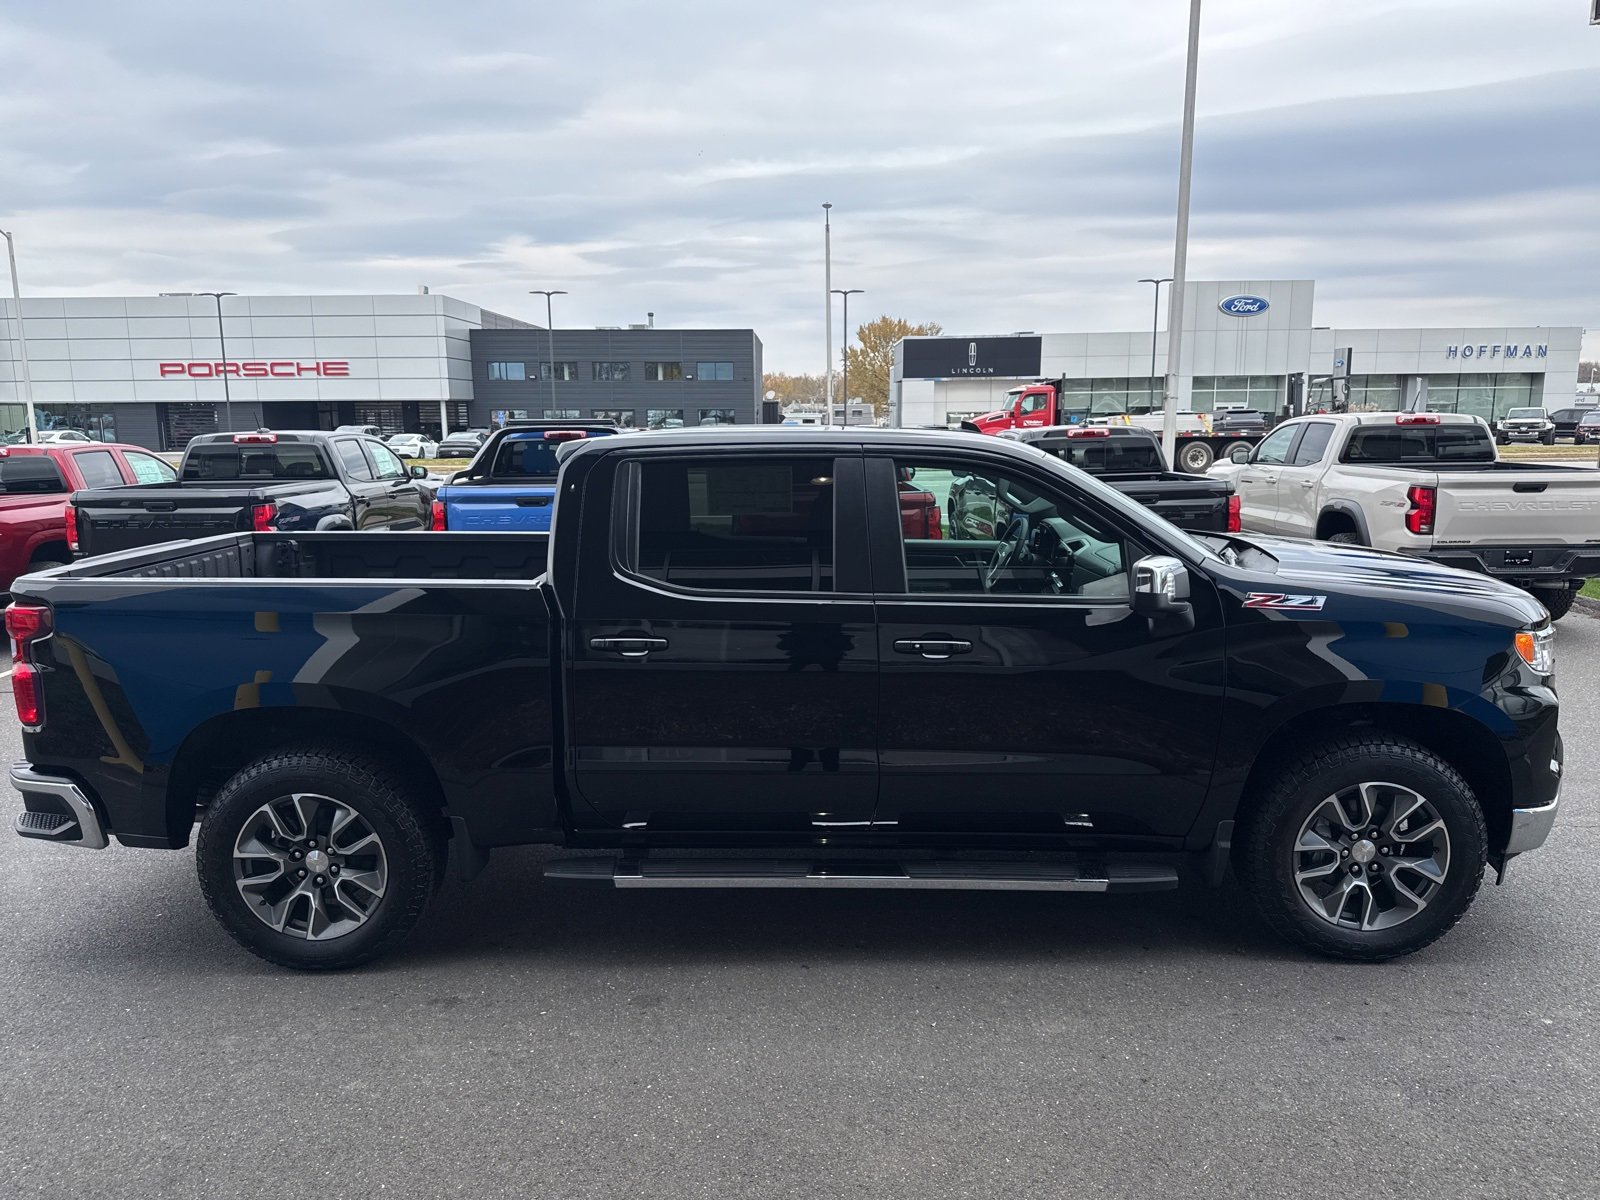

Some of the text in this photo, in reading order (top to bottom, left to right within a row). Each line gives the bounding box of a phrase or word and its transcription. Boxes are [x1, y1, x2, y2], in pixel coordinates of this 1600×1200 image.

[1231, 299, 1260, 312] Ford
[1447, 345, 1548, 358] HOFFMAN
[159, 362, 350, 377] PORSCHE
[1458, 501, 1597, 511] CHEVROLET
[1241, 592, 1327, 611] Z71
